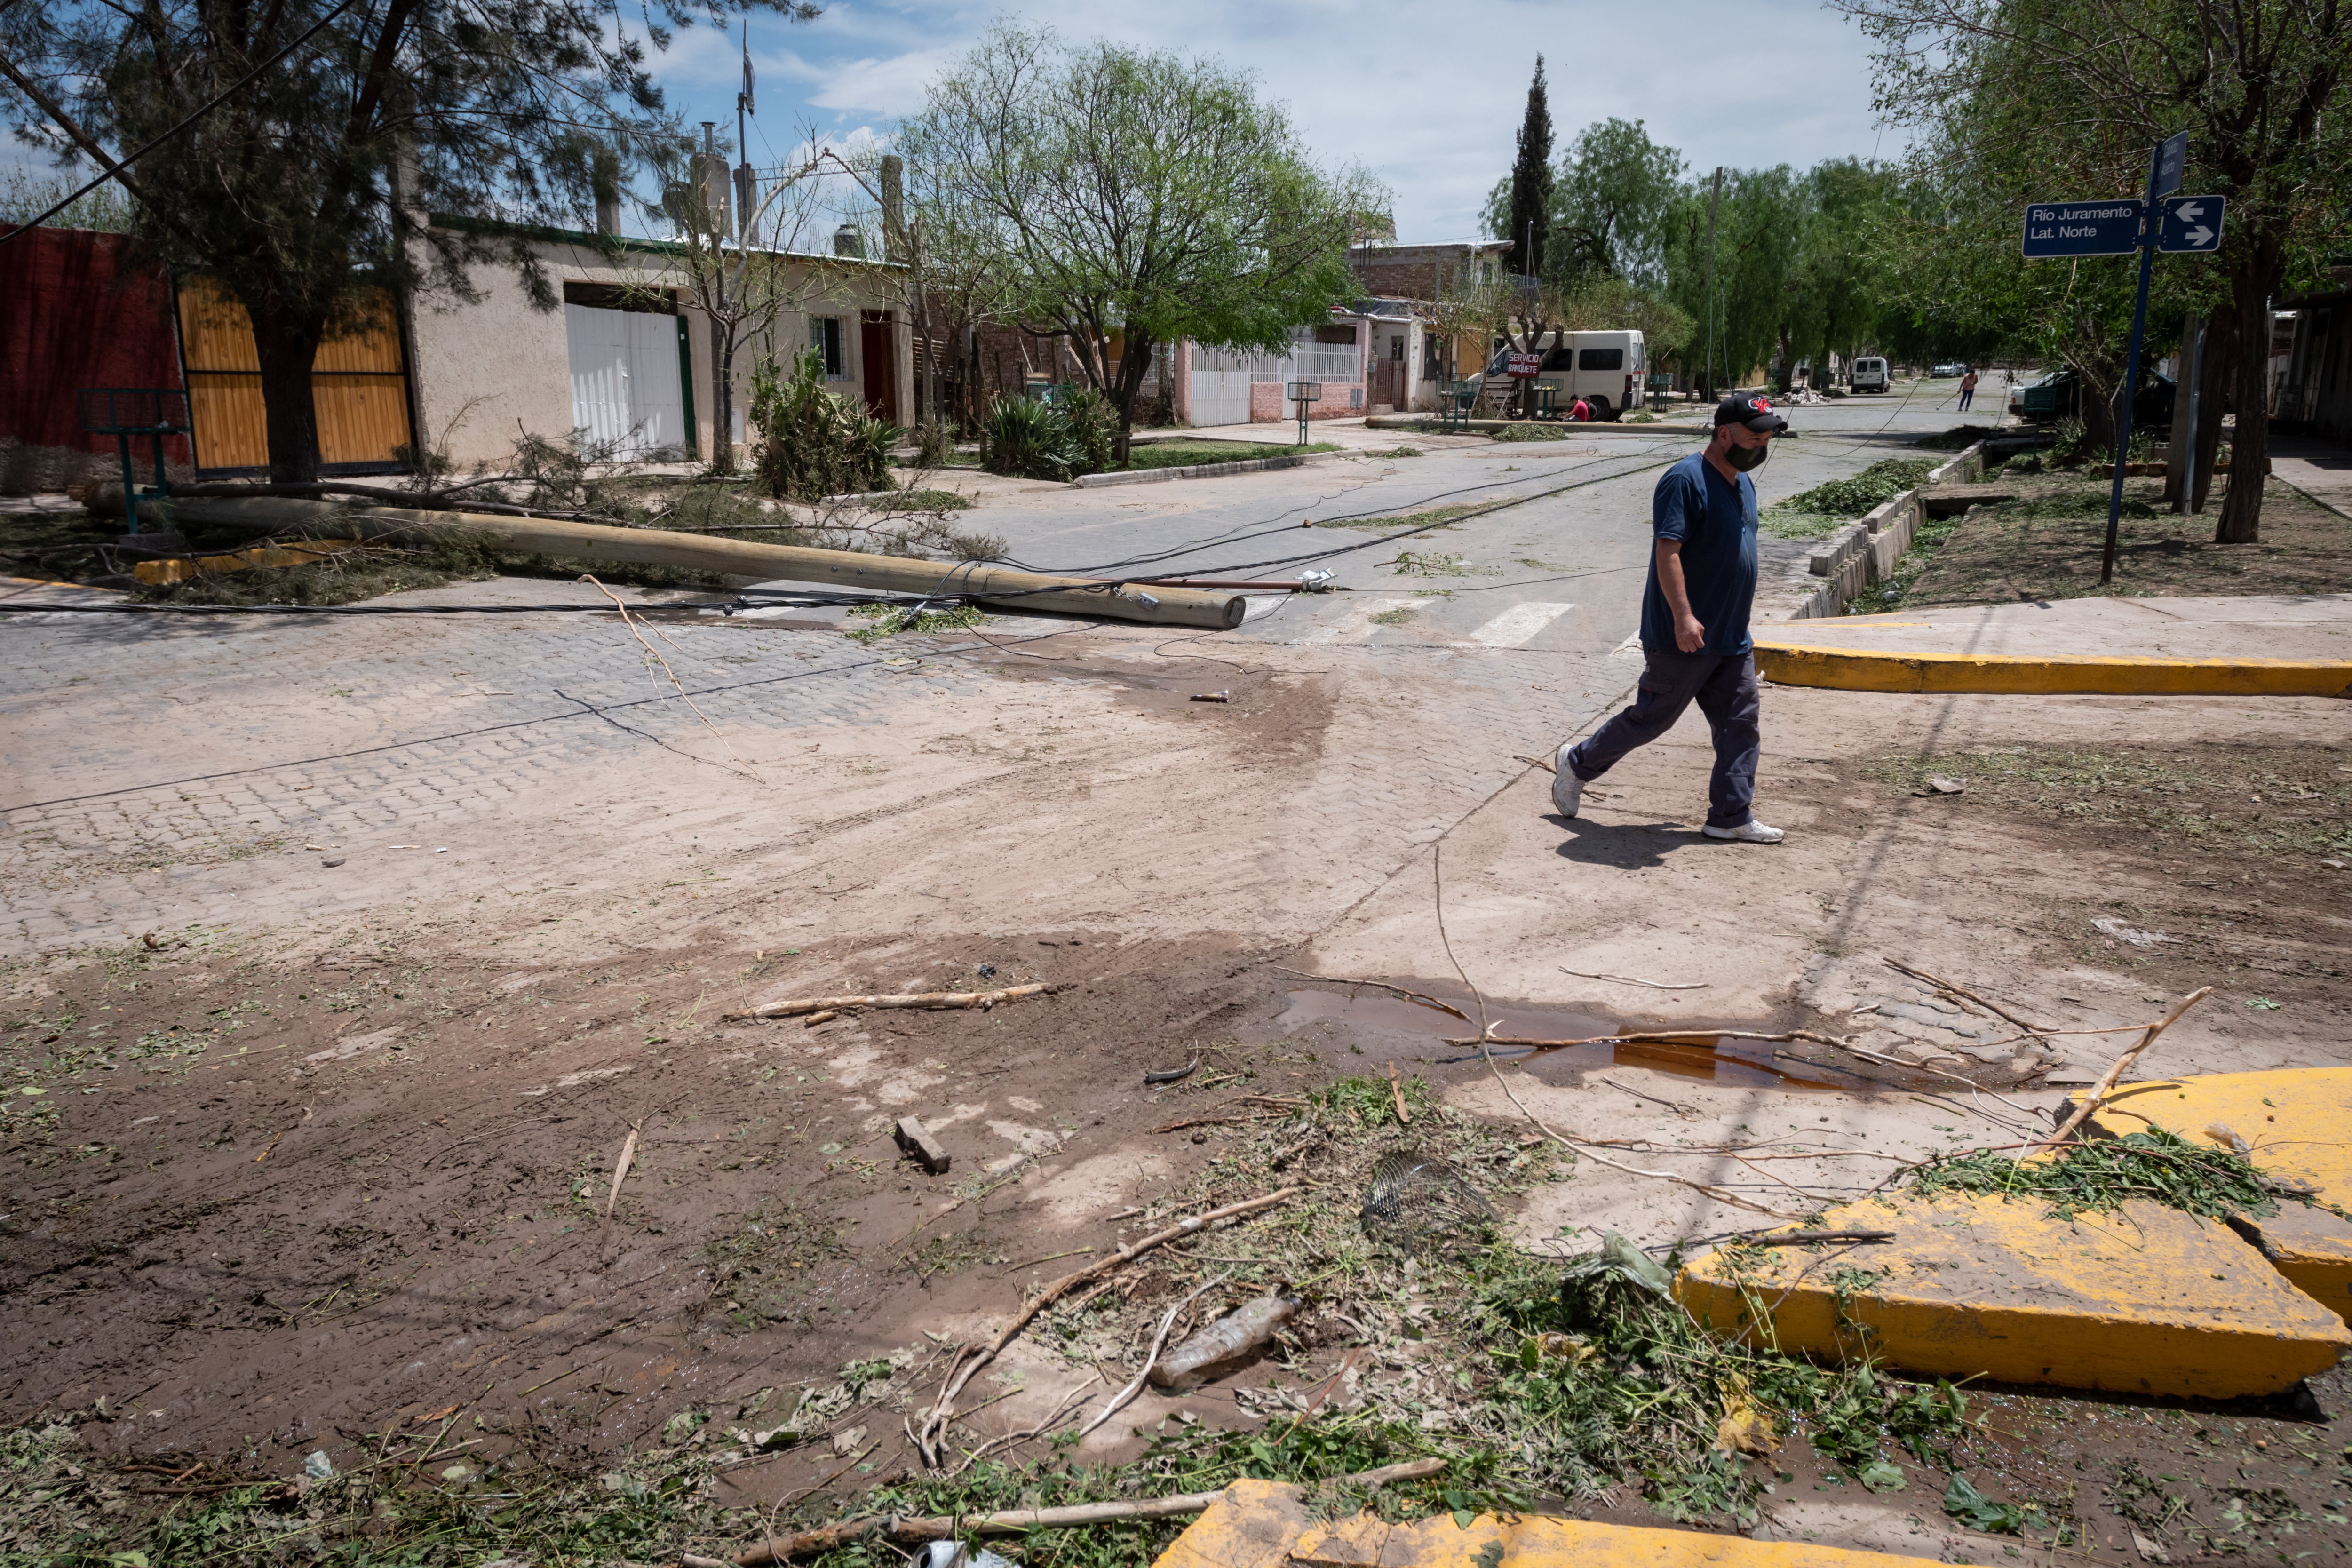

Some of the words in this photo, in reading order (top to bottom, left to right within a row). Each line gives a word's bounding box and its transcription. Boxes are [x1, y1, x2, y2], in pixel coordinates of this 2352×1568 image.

[2033, 209, 2055, 221] Río
[2058, 207, 2132, 220] Juramento
[2030, 227, 2055, 239] Lat.
[2059, 226, 2097, 238] Norte
[1509, 353, 1539, 363] SERVICIO
[1508, 364, 1537, 374] BANQUETE
